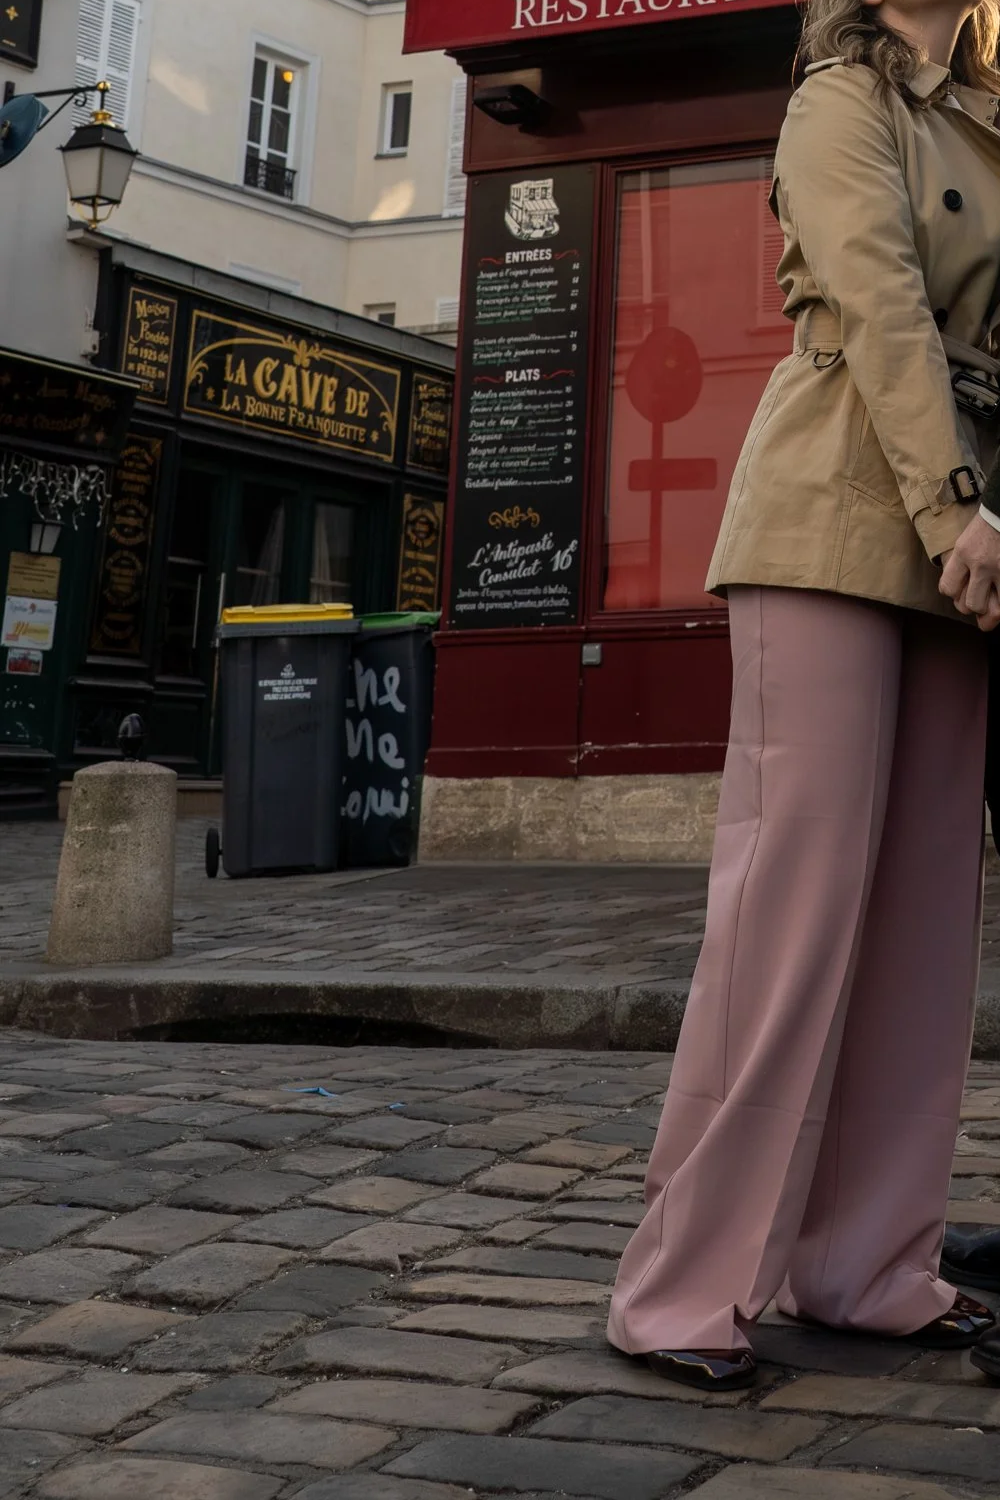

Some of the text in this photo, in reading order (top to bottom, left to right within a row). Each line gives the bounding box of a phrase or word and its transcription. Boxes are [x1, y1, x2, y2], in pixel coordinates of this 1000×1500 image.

[505, 248, 553, 264] ENTRÉES
[224, 353, 370, 418] LA CAVE DE
[505, 368, 541, 384] PLATS
[467, 531, 555, 568] L'Antipasti
[479, 558, 543, 587] Consulat
